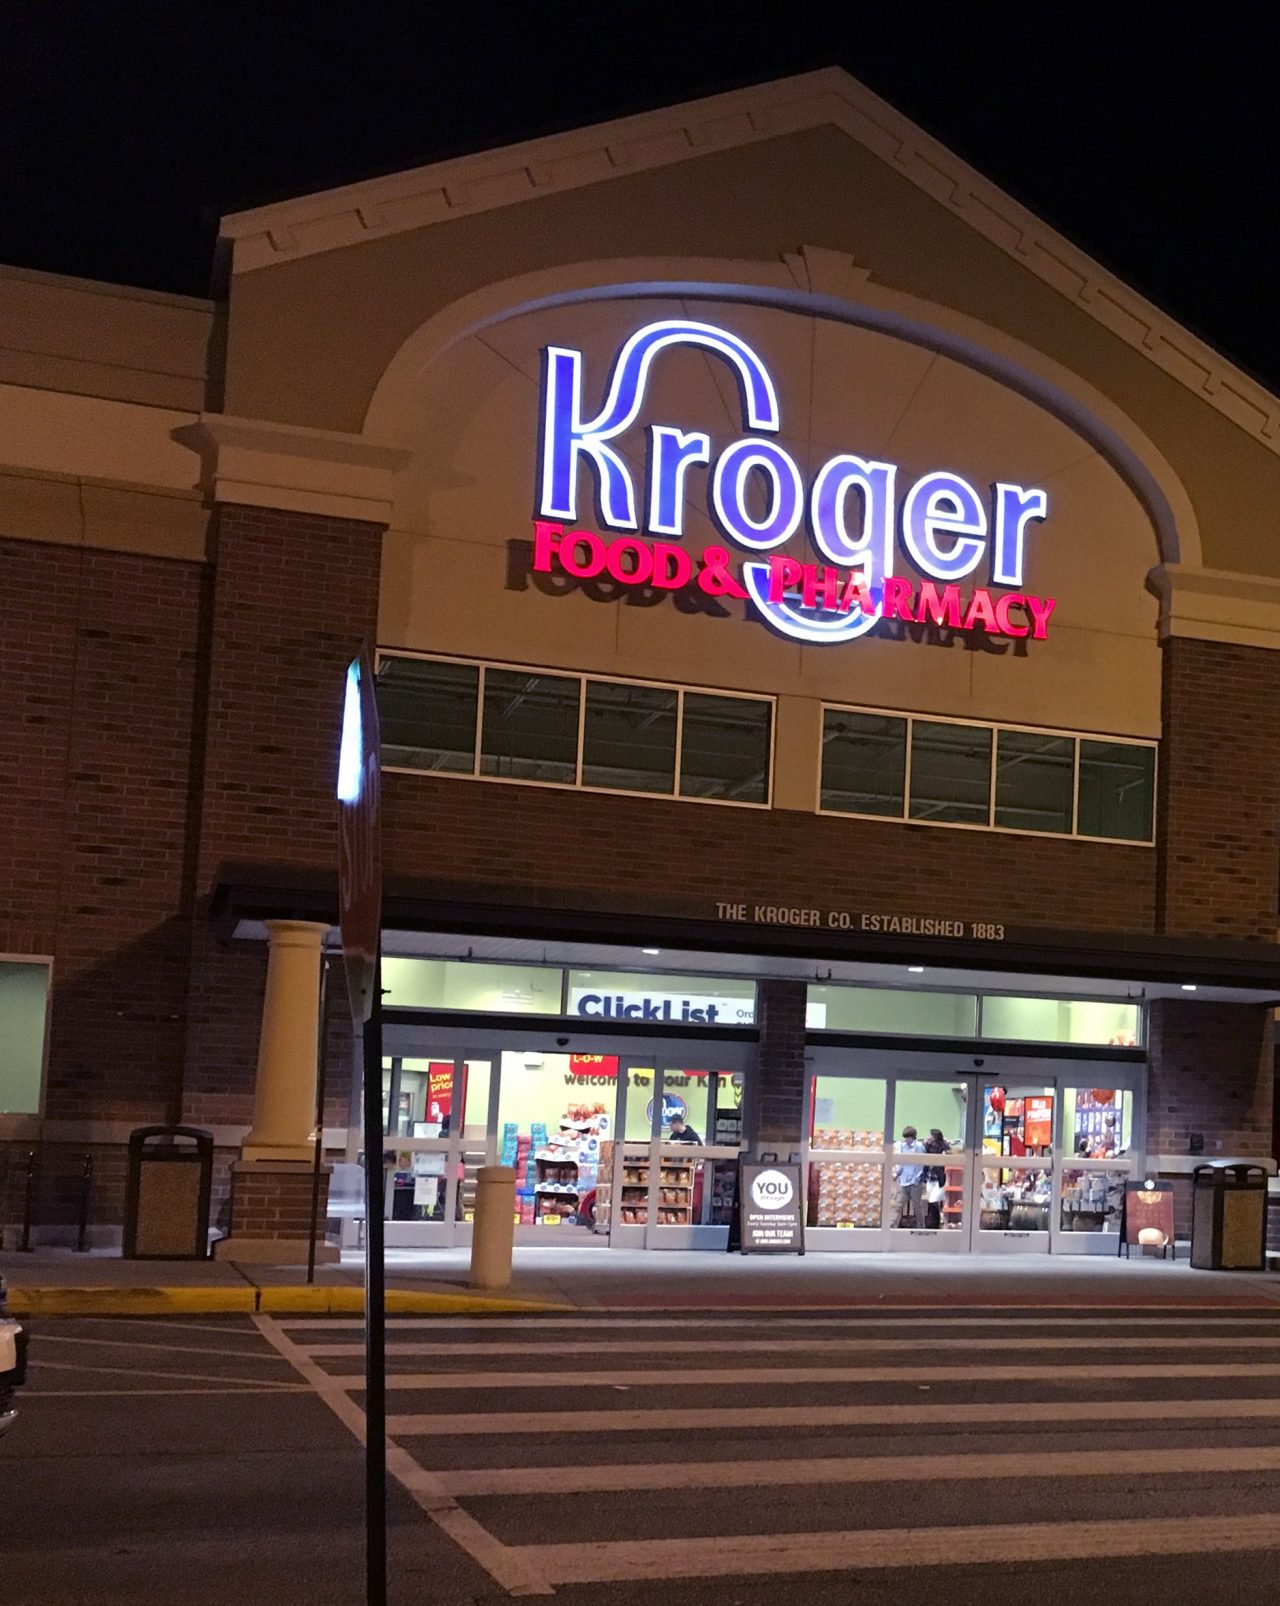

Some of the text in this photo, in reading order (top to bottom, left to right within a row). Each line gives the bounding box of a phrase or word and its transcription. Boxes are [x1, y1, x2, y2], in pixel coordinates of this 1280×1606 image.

[540, 319, 1048, 643] Kroger
[533, 521, 692, 589] FOOD
[767, 555, 1057, 641] PHARMACY
[716, 903, 1005, 941] THE KROGER CO. ESTABLISHED 1883
[577, 994, 719, 1024] ClickList
[430, 1081, 453, 1093] pric
[634, 1073, 650, 1086] to
[664, 1075, 692, 1087] our
[697, 1075, 727, 1088] Kn
[757, 1182, 788, 1195] YOU
